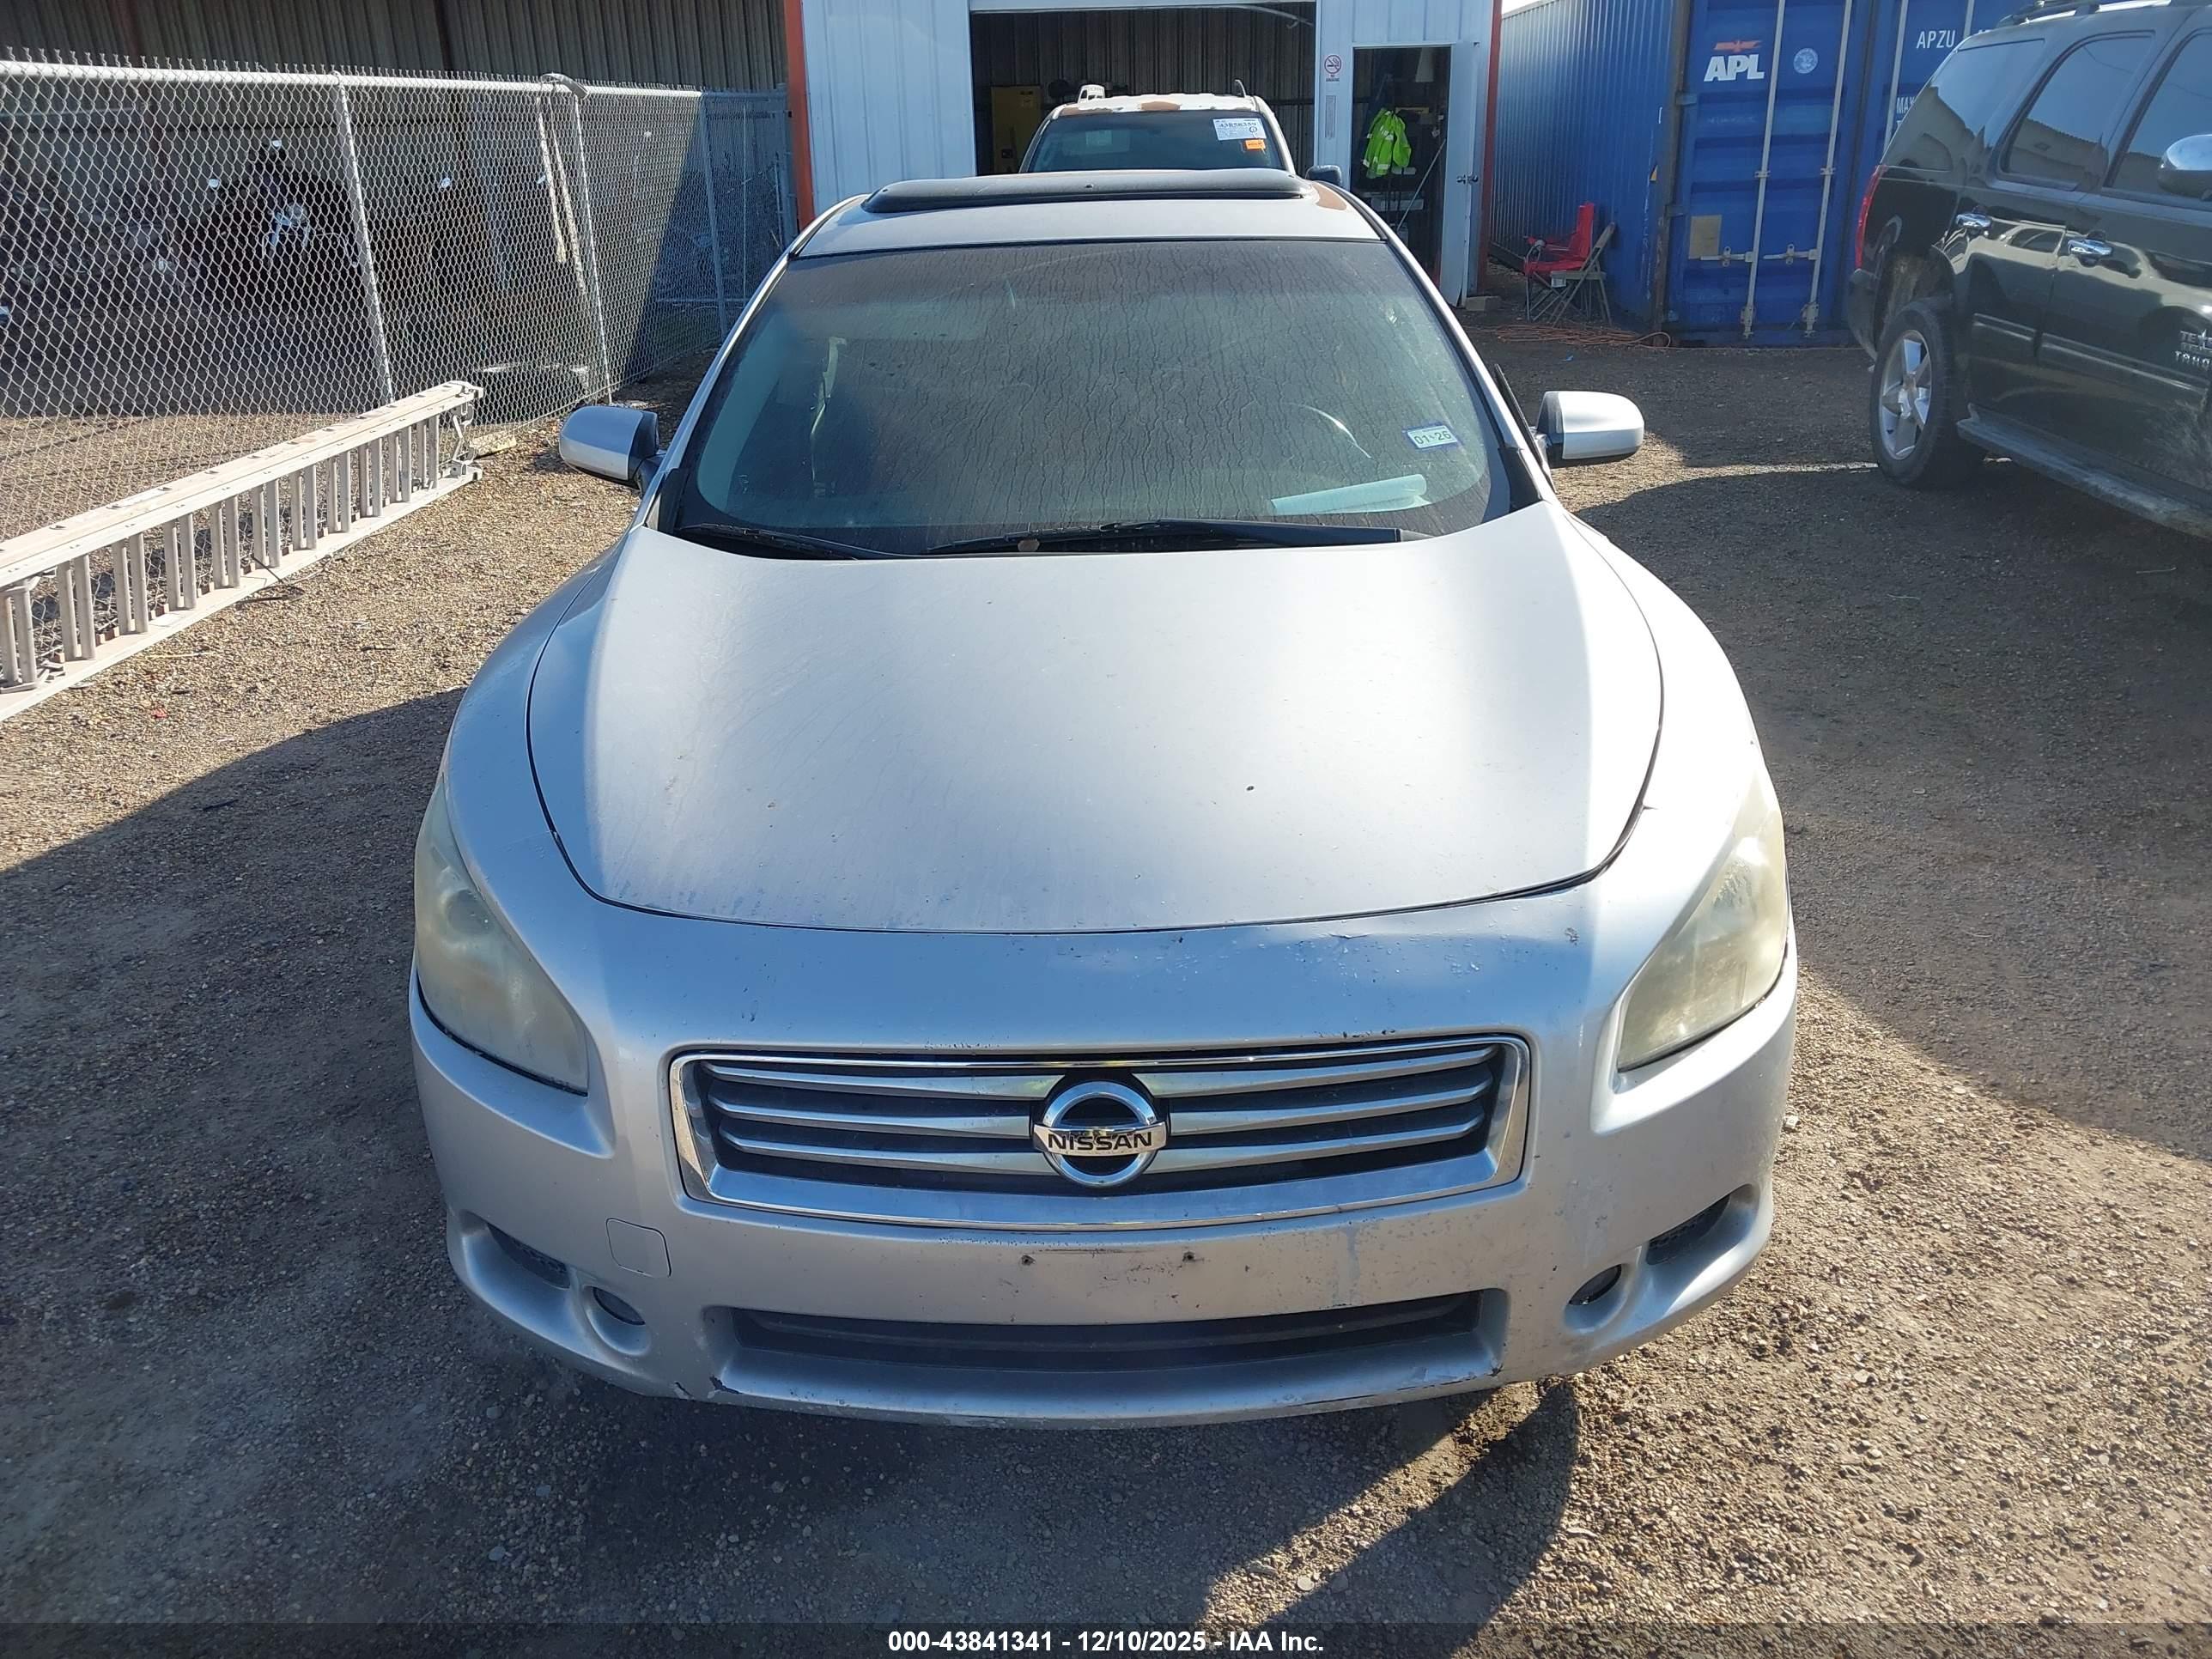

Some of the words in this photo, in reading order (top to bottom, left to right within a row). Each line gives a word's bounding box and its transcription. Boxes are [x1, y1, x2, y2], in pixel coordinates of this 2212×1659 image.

[1916, 30, 1956, 49] APZU
[1704, 53, 1765, 82] APL
[1047, 1131, 1152, 1151] NISSAN
